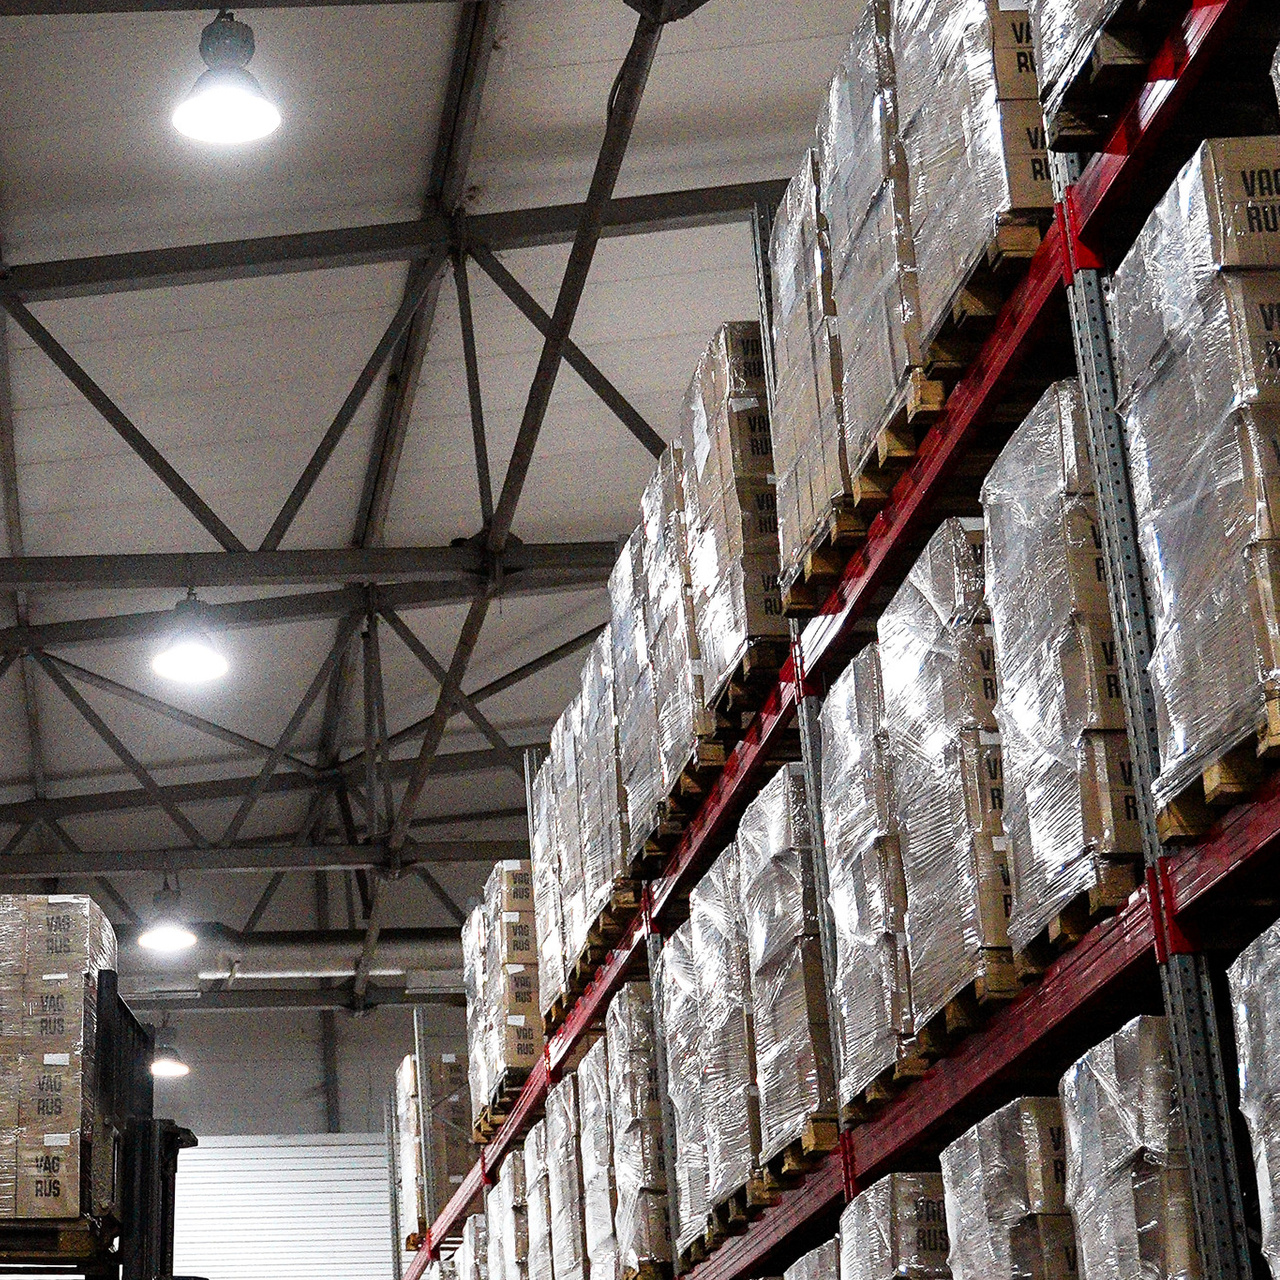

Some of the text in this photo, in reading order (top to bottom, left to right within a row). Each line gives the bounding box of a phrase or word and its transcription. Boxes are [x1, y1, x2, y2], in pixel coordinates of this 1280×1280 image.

[1246, 205, 1280, 233] RU
[748, 415, 769, 432] VA
[751, 438, 770, 456] RU
[760, 515, 778, 533] RU
[35, 1156, 60, 1174] VAG
[35, 1180, 60, 1197] RUS
